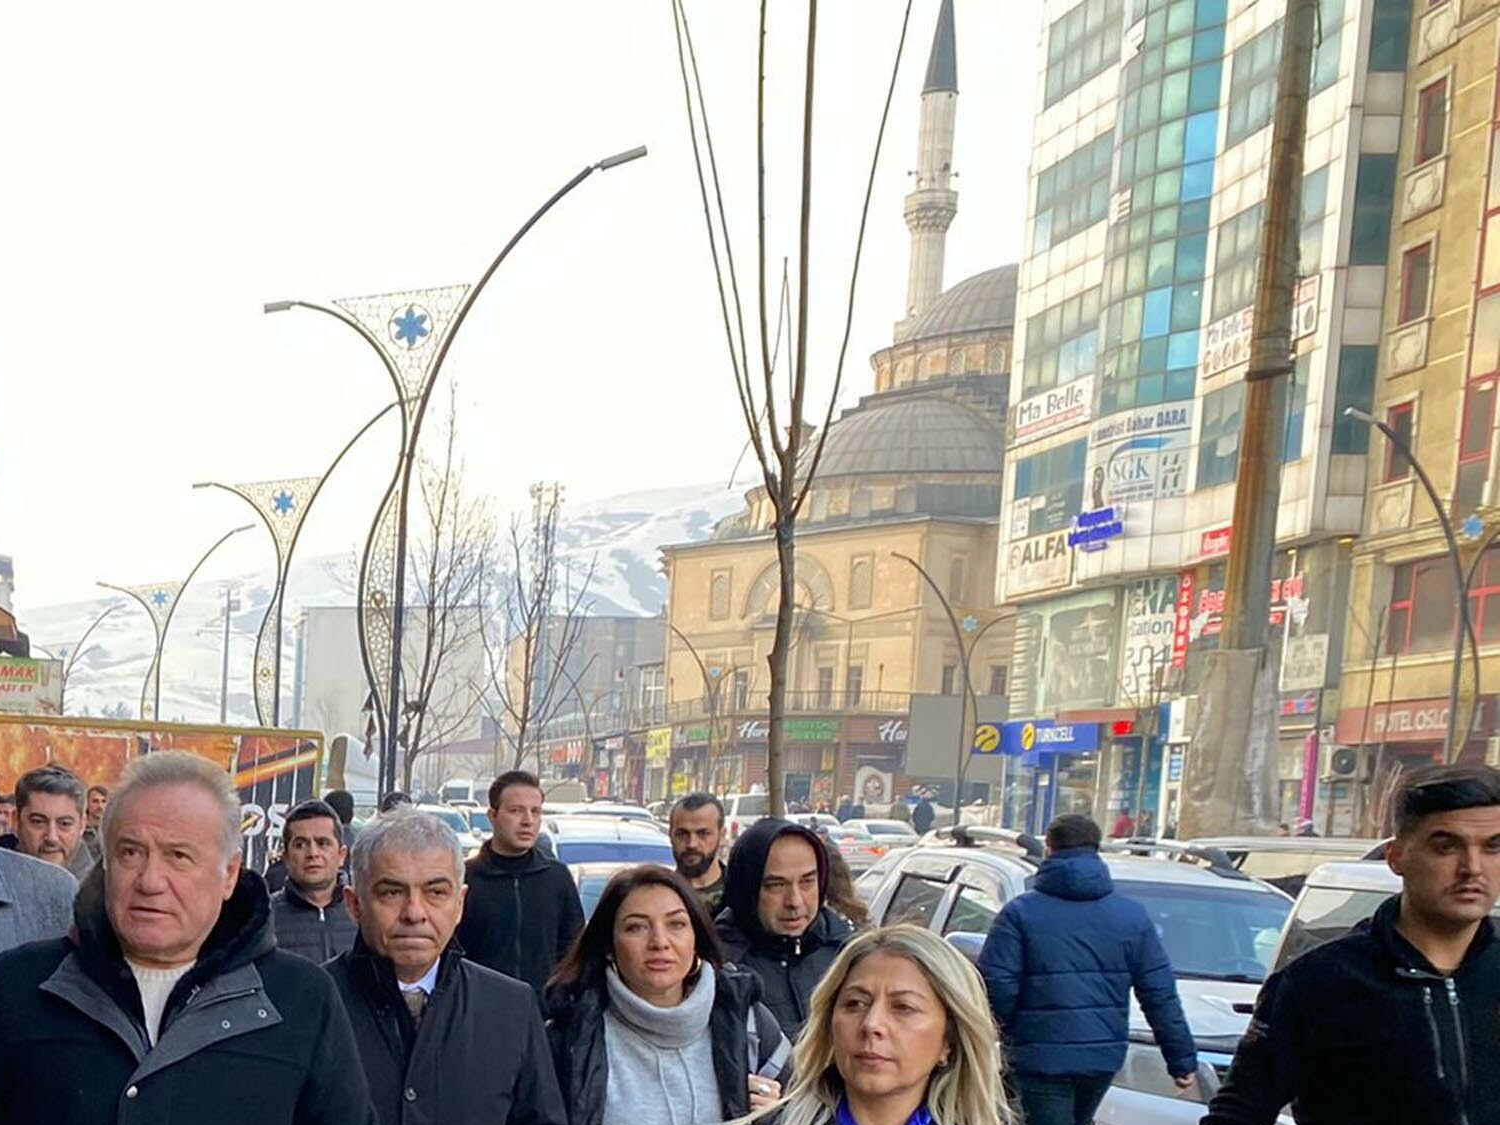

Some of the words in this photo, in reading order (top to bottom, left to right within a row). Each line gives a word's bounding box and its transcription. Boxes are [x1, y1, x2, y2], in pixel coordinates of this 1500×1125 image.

[1018, 402, 1041, 425] Ma
[1046, 384, 1084, 415] Belle
[1111, 455, 1150, 481] SGK
[1021, 534, 1067, 565] ALFA
[1036, 725, 1076, 743] TURKCELL
[1374, 709, 1413, 734] HOTEL
